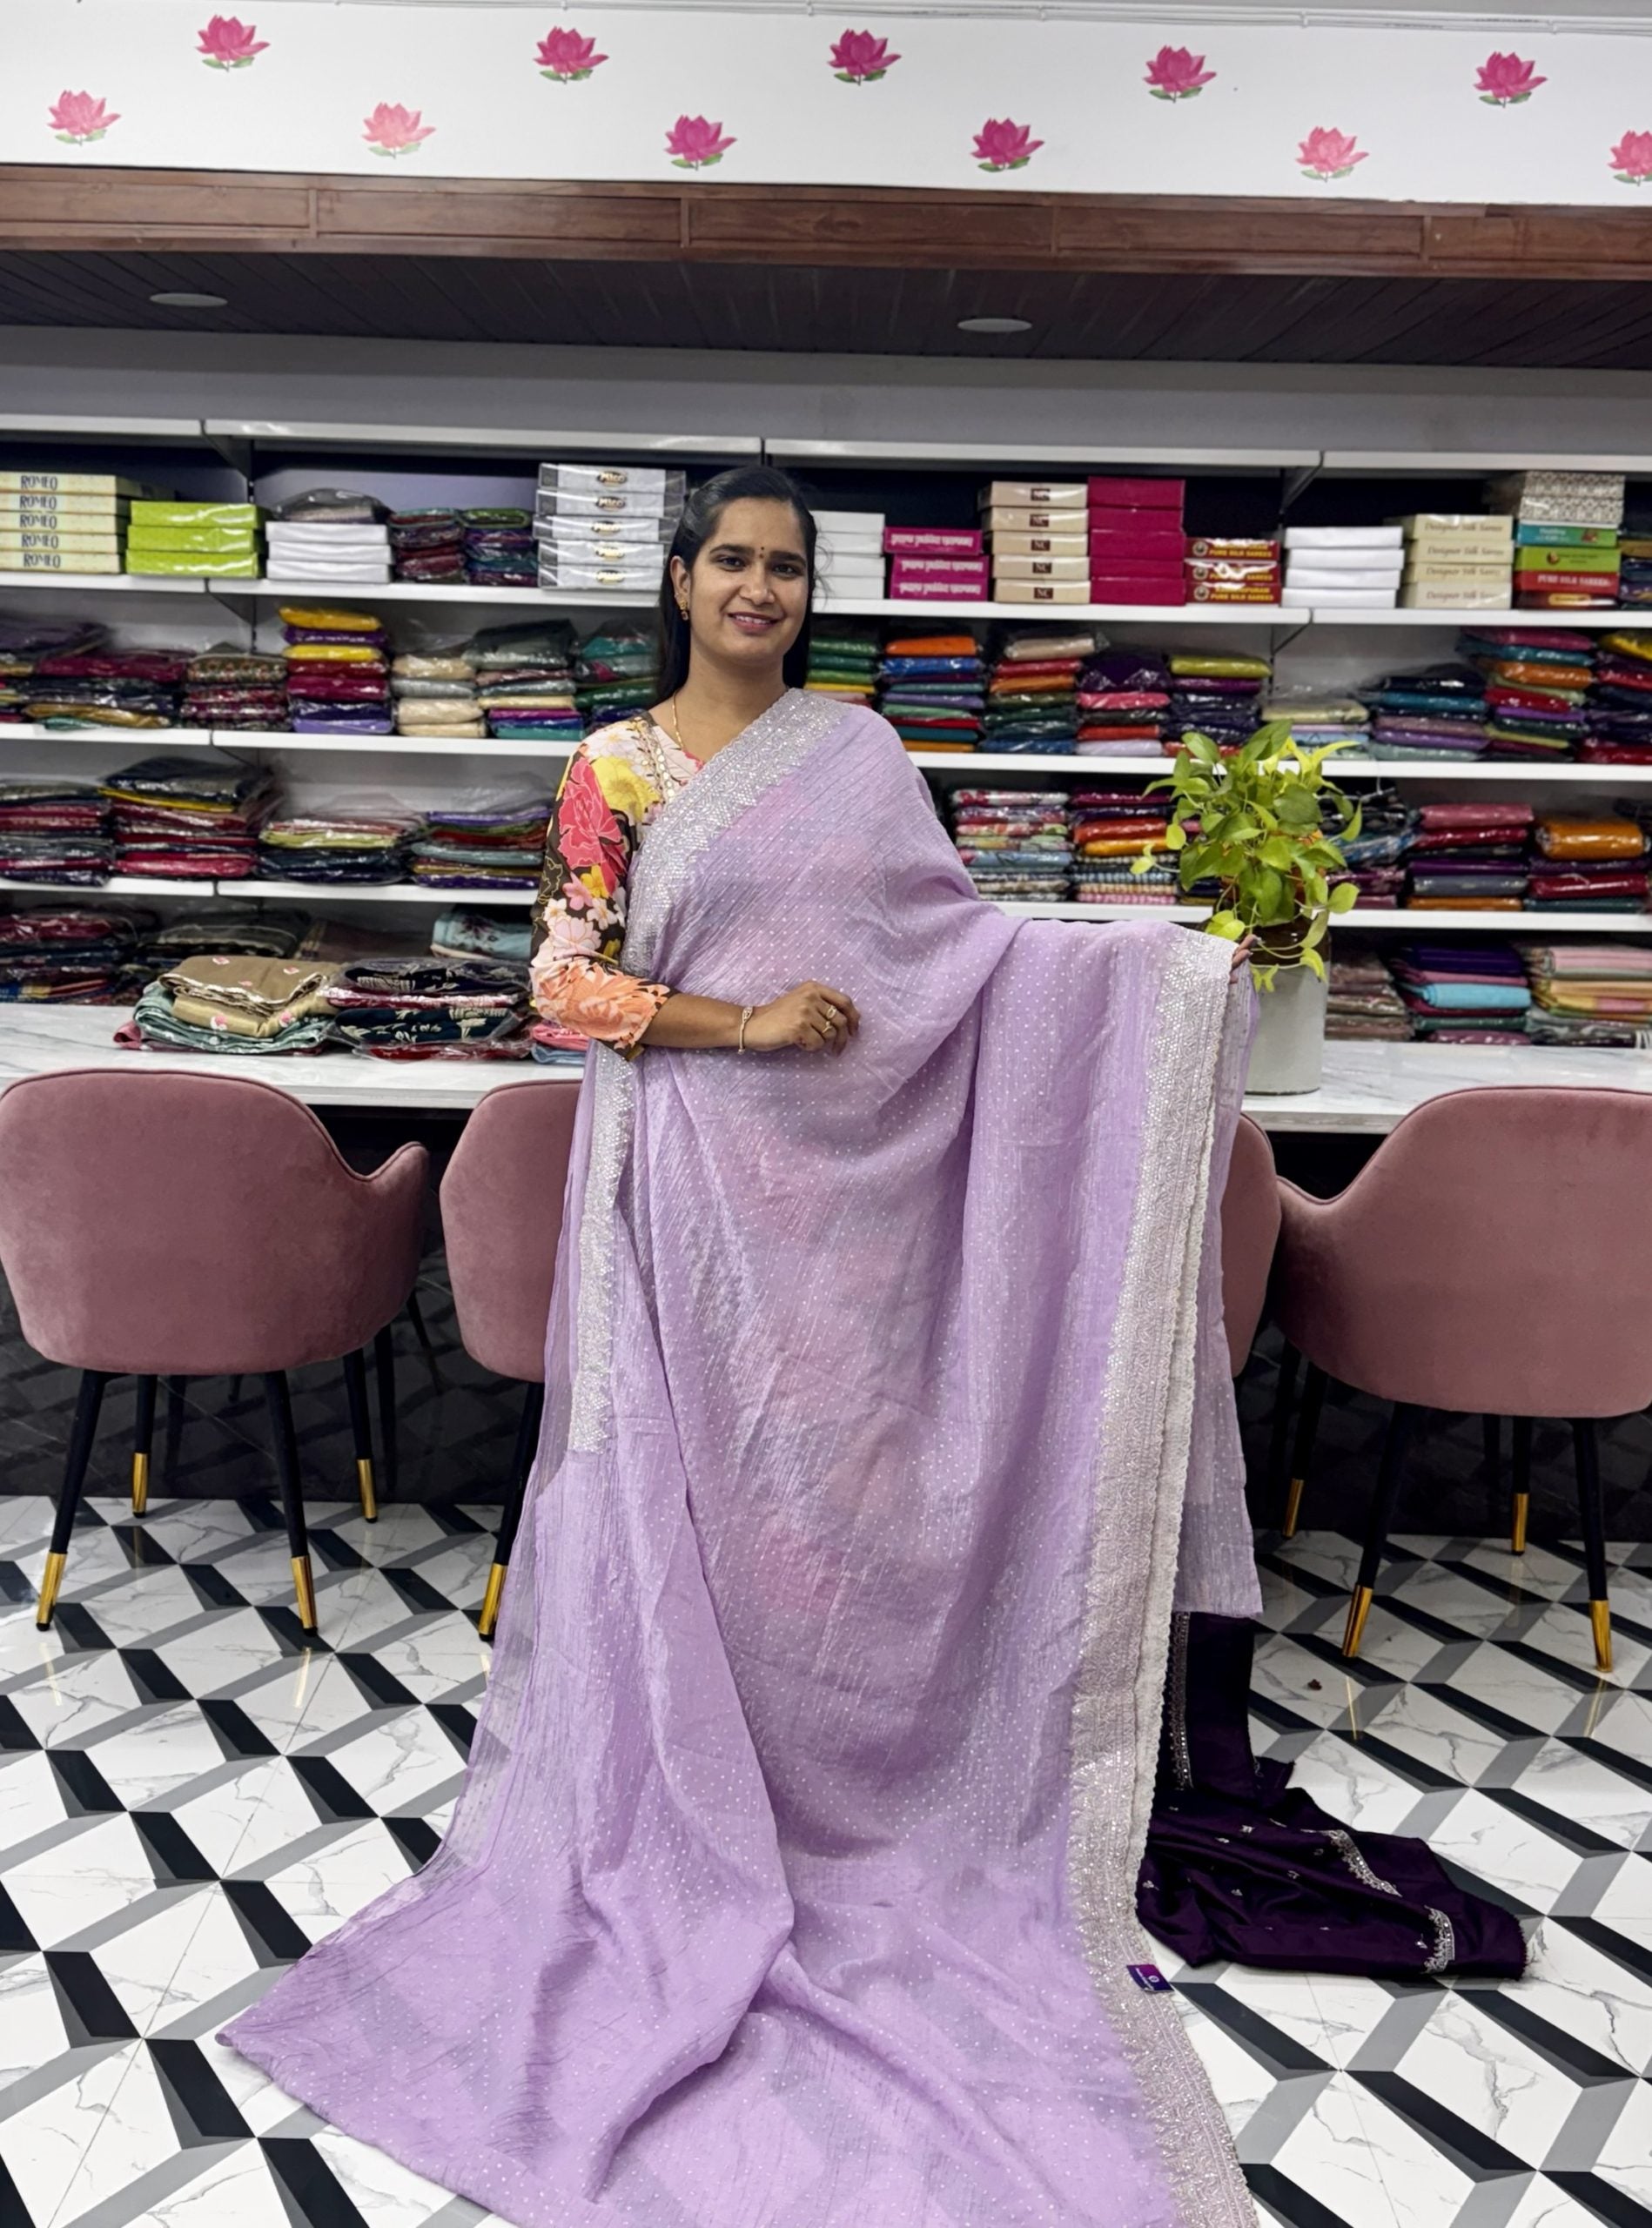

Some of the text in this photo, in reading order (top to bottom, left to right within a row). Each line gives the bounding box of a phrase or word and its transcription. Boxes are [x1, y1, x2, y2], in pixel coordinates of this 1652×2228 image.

[21, 475, 57, 491] ROMEO
[20, 495, 57, 510] ROMEO
[20, 514, 57, 530] ROMEO
[22, 534, 58, 549] ROMEO
[1428, 546, 1461, 557] Designer
[24, 554, 61, 568] ROMEO
